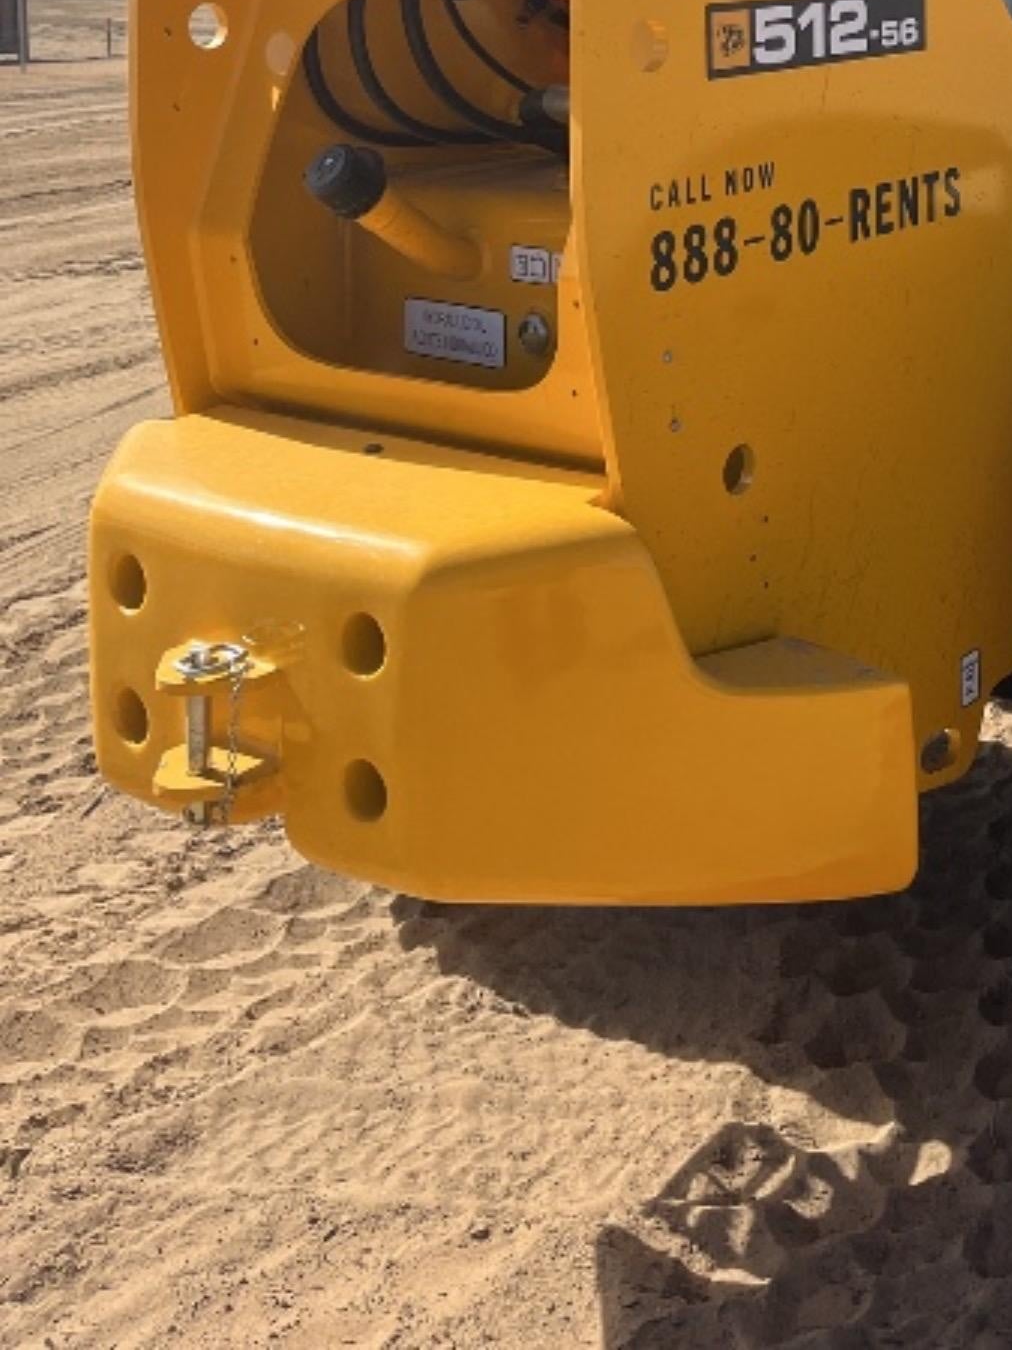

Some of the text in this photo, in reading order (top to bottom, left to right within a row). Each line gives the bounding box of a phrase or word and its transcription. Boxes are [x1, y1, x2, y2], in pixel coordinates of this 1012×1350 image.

[650, 161, 776, 212] CALL NOW
[650, 167, 961, 292] 888-80-RENTS
